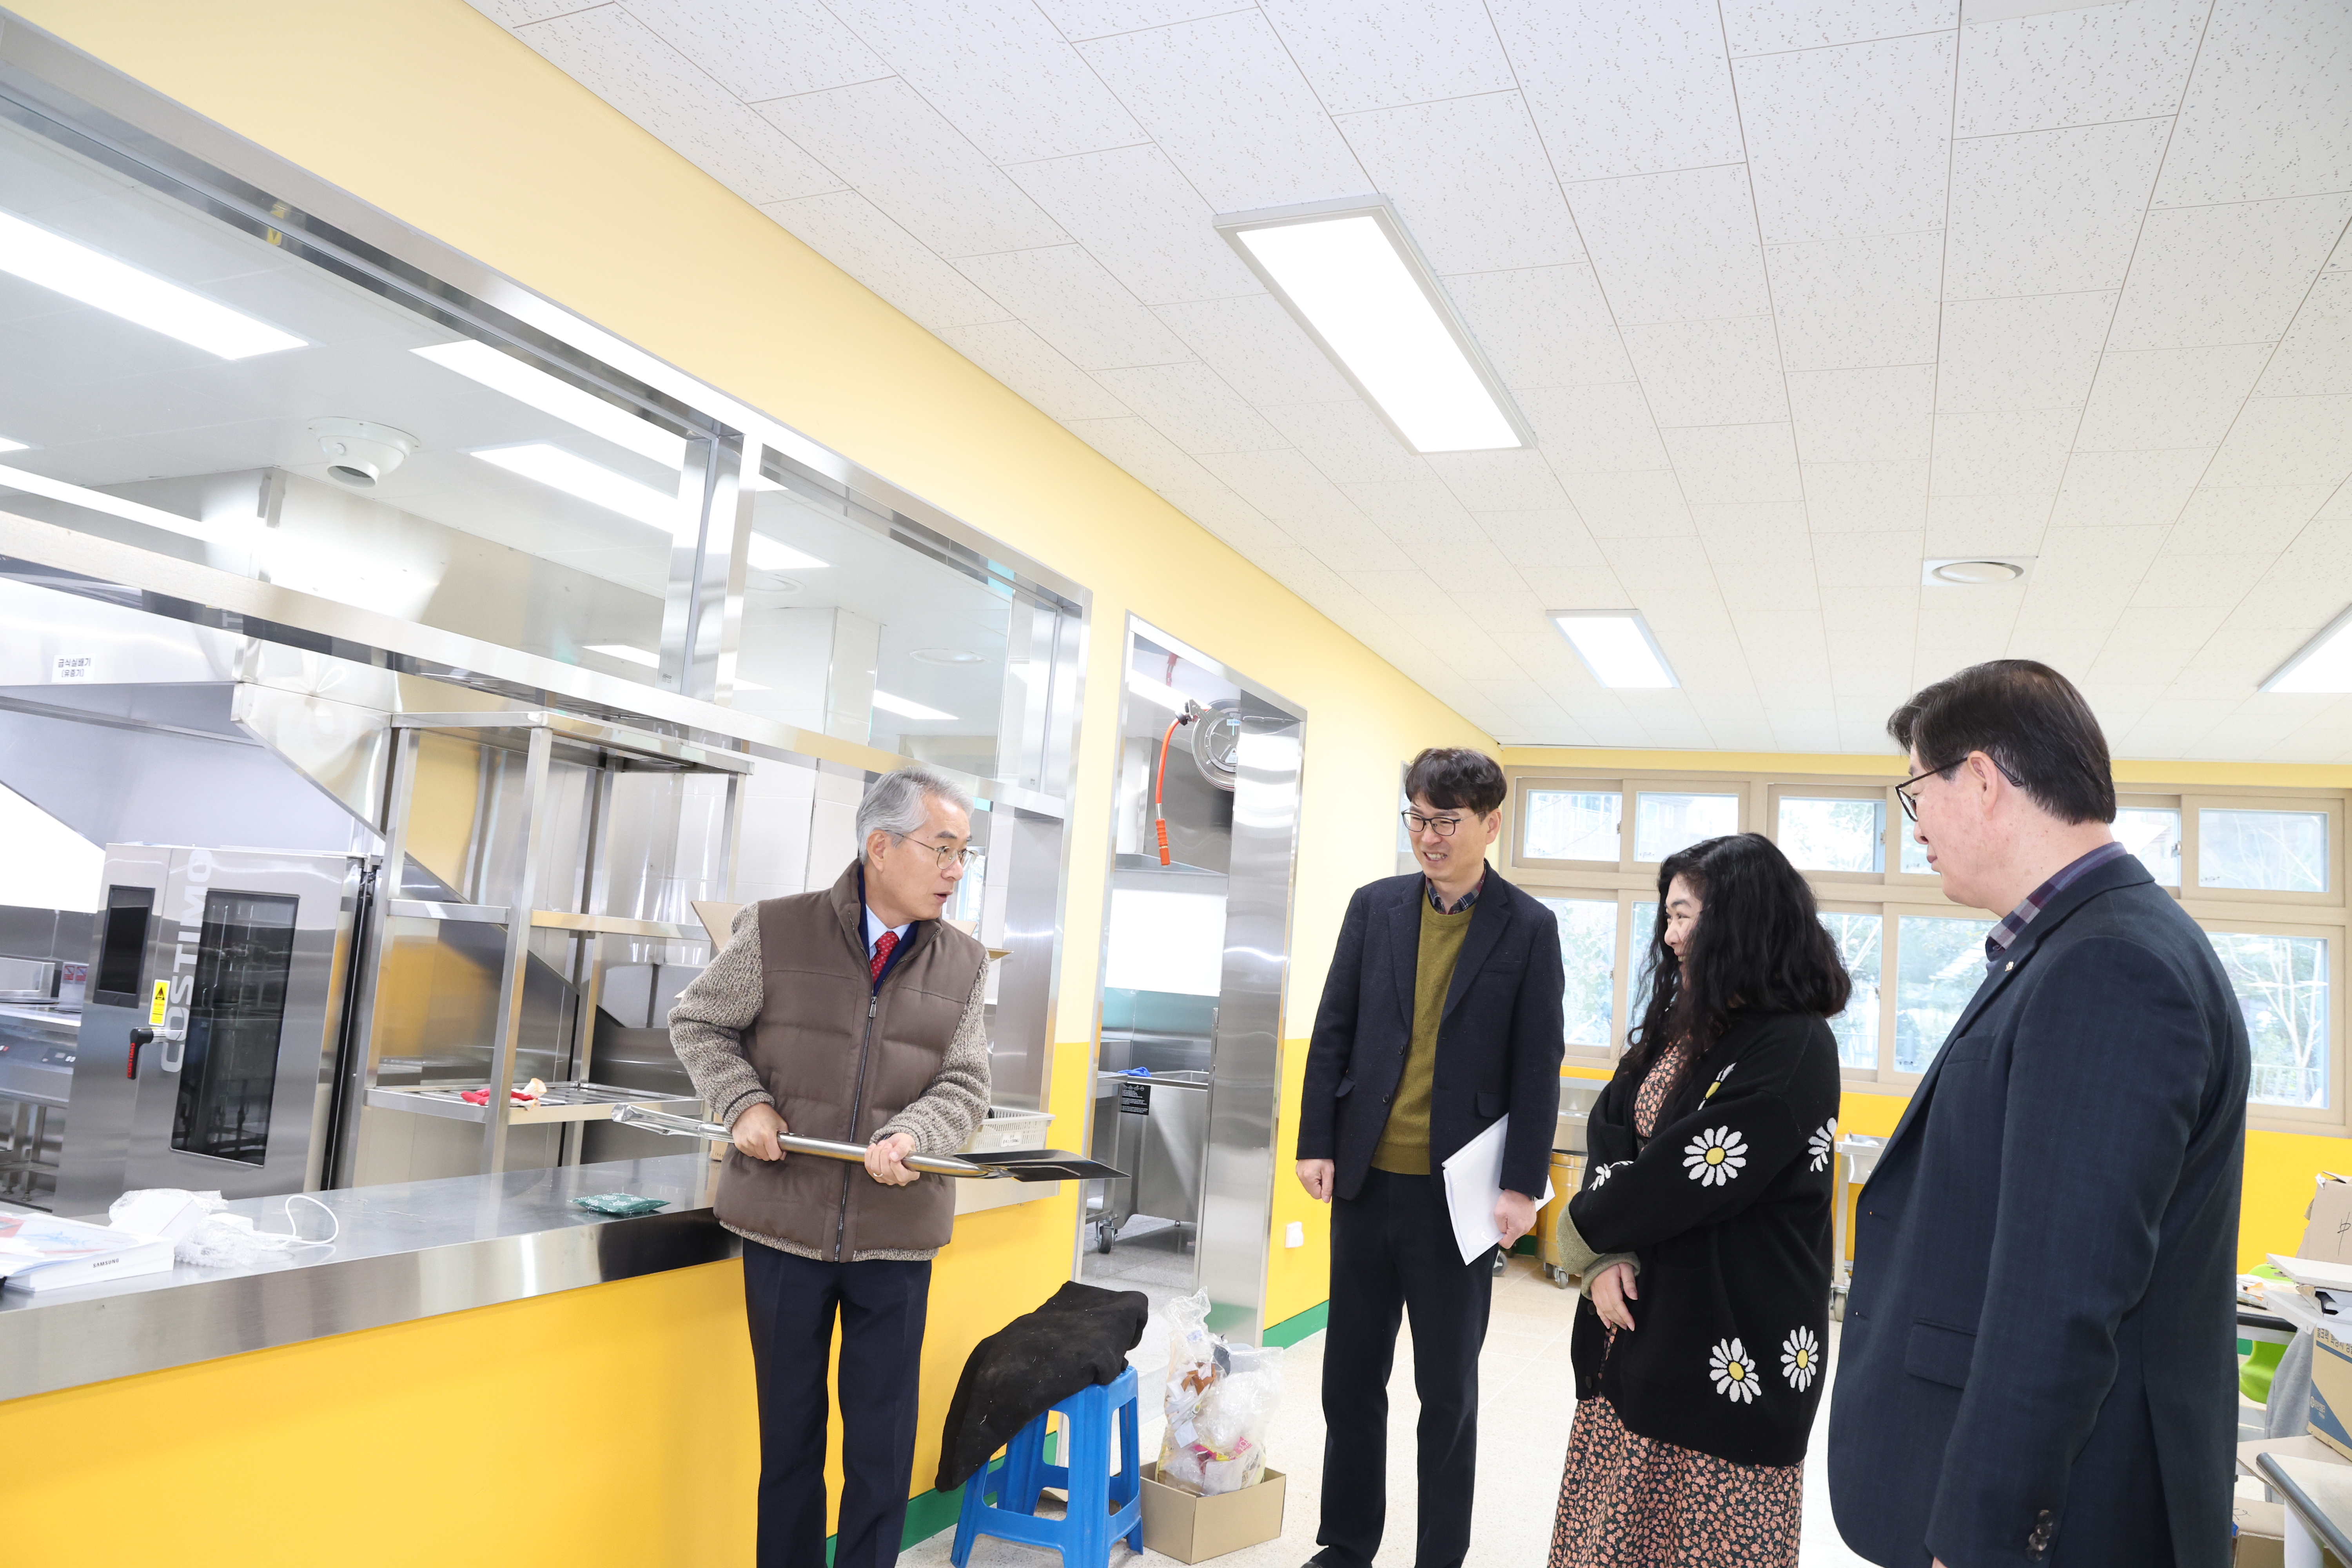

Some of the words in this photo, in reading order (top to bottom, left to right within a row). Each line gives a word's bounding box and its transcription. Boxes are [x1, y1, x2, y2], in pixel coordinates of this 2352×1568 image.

[58, 658, 91, 667] 급식실배기
[160, 849, 213, 1073] COSTIMO
[93, 1258, 119, 1268] SAMSUNG
